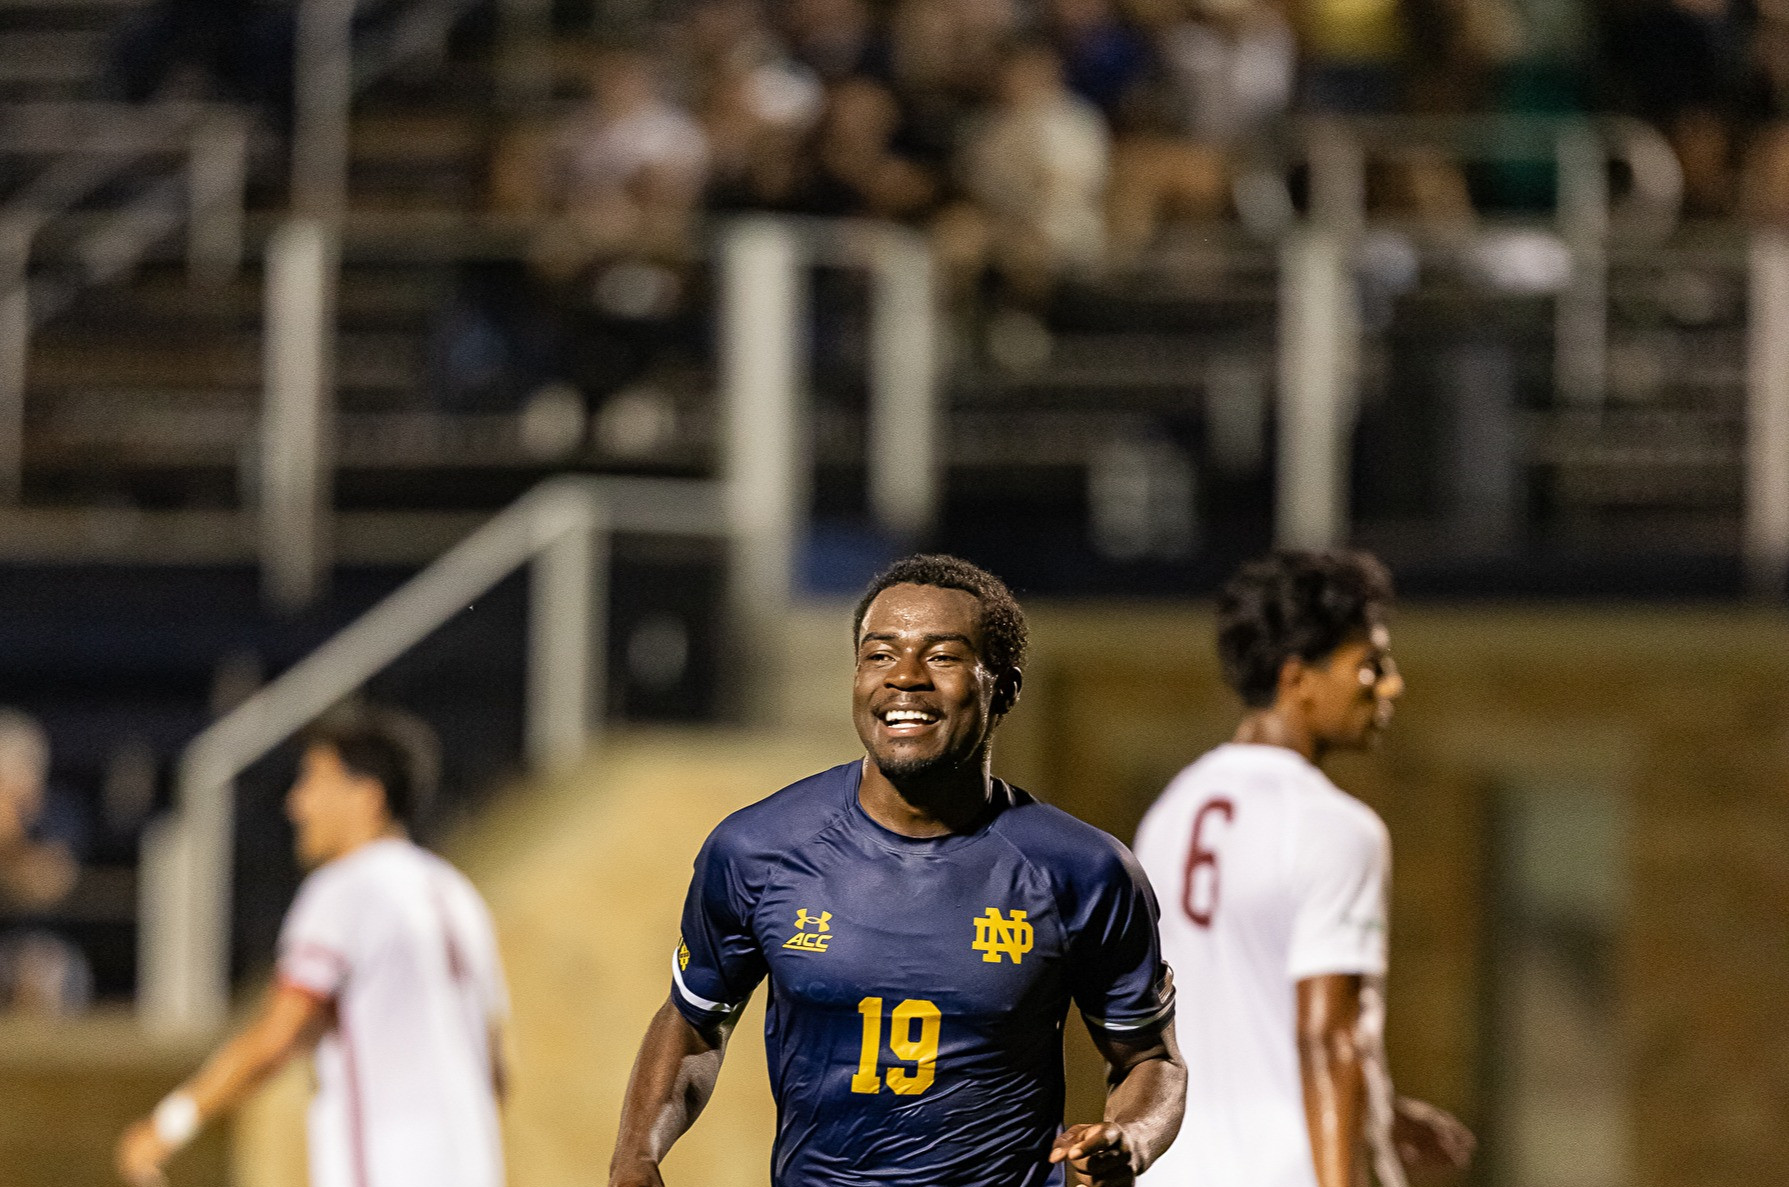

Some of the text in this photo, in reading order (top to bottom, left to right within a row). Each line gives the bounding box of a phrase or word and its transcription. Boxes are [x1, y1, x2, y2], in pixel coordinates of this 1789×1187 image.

[1181, 796, 1237, 929] 6
[785, 932, 833, 949] ACC
[851, 996, 942, 1096] 19
